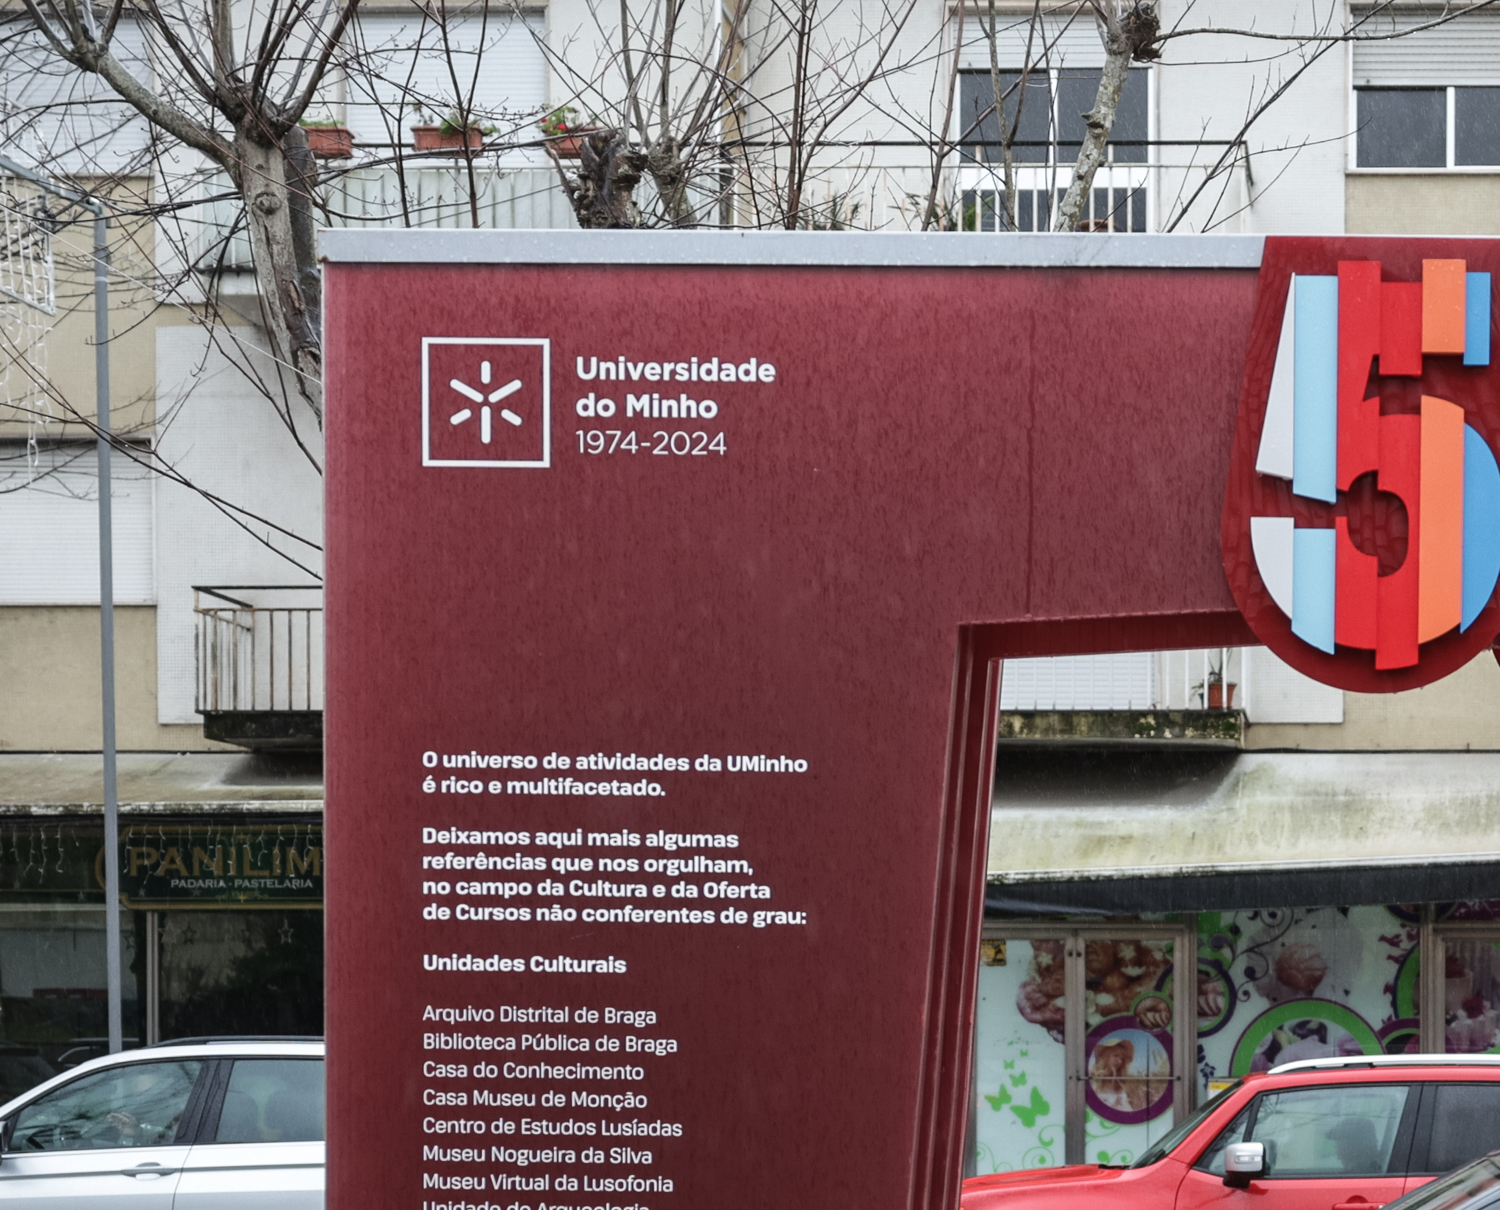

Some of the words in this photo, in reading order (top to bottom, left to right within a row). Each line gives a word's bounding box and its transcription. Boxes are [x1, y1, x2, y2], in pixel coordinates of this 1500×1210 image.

[576, 355, 777, 383] Universidade
[575, 392, 616, 418] do
[626, 392, 718, 419] Minho
[575, 429, 727, 456] 1974-2024
[422, 750, 438, 768] O
[442, 750, 538, 770] universo
[542, 751, 571, 770] de
[575, 752, 690, 772] atividades
[694, 753, 722, 772] da
[726, 754, 808, 773] UMinho
[422, 774, 437, 794] é
[441, 775, 484, 794] rico
[487, 780, 503, 795] e
[506, 777, 666, 797] multifacetado.
[422, 826, 531, 846] Deixamos
[534, 828, 583, 850] aqui
[587, 828, 641, 847] mais
[645, 829, 739, 851] algumas
[422, 851, 547, 871] referências
[551, 857, 594, 875] que
[598, 858, 640, 873] nos
[643, 855, 754, 877] orgulham,
[171, 879, 226, 888] PADARIA
[234, 879, 313, 888] PASTELARIA
[422, 881, 451, 895] no
[455, 881, 533, 899] campo
[536, 878, 565, 897] da
[569, 879, 648, 898] Cultura
[652, 884, 667, 898] e
[670, 880, 699, 899] da
[703, 880, 771, 899] Oferta
[422, 902, 451, 921] de
[455, 903, 532, 922] Cursos
[536, 903, 578, 922] não
[581, 904, 716, 924] conferentes
[719, 906, 749, 925] de
[752, 910, 807, 928] grau:
[423, 953, 526, 972] Unidades
[529, 955, 627, 974] Culturais
[422, 1004, 495, 1025] Arquivo
[499, 1005, 569, 1023] Distrital
[574, 1006, 600, 1024] de
[604, 1007, 657, 1028] Braga
[423, 1032, 517, 1051] Biblioteca
[521, 1033, 590, 1052] Pública
[594, 1034, 620, 1052] de
[625, 1035, 678, 1057] Braga
[423, 1060, 468, 1078] Casa
[472, 1060, 499, 1079] do
[503, 1061, 645, 1081] Conhecimento
[423, 1088, 468, 1106] Casa
[473, 1089, 536, 1107] Museu
[541, 1089, 567, 1108] de
[571, 1090, 648, 1112] Monção
[422, 1116, 486, 1135] Centro
[490, 1117, 516, 1135] de
[521, 1118, 597, 1136] Estudos
[601, 1118, 683, 1137] Lusíadas
[423, 1144, 486, 1163] Museu
[491, 1145, 576, 1167] Nogueira
[580, 1146, 605, 1164] da
[609, 1146, 653, 1165] Silva
[423, 1172, 486, 1191] Museu
[489, 1173, 550, 1191] Virtual
[554, 1174, 579, 1192] da
[583, 1174, 674, 1193] Lusofonia
